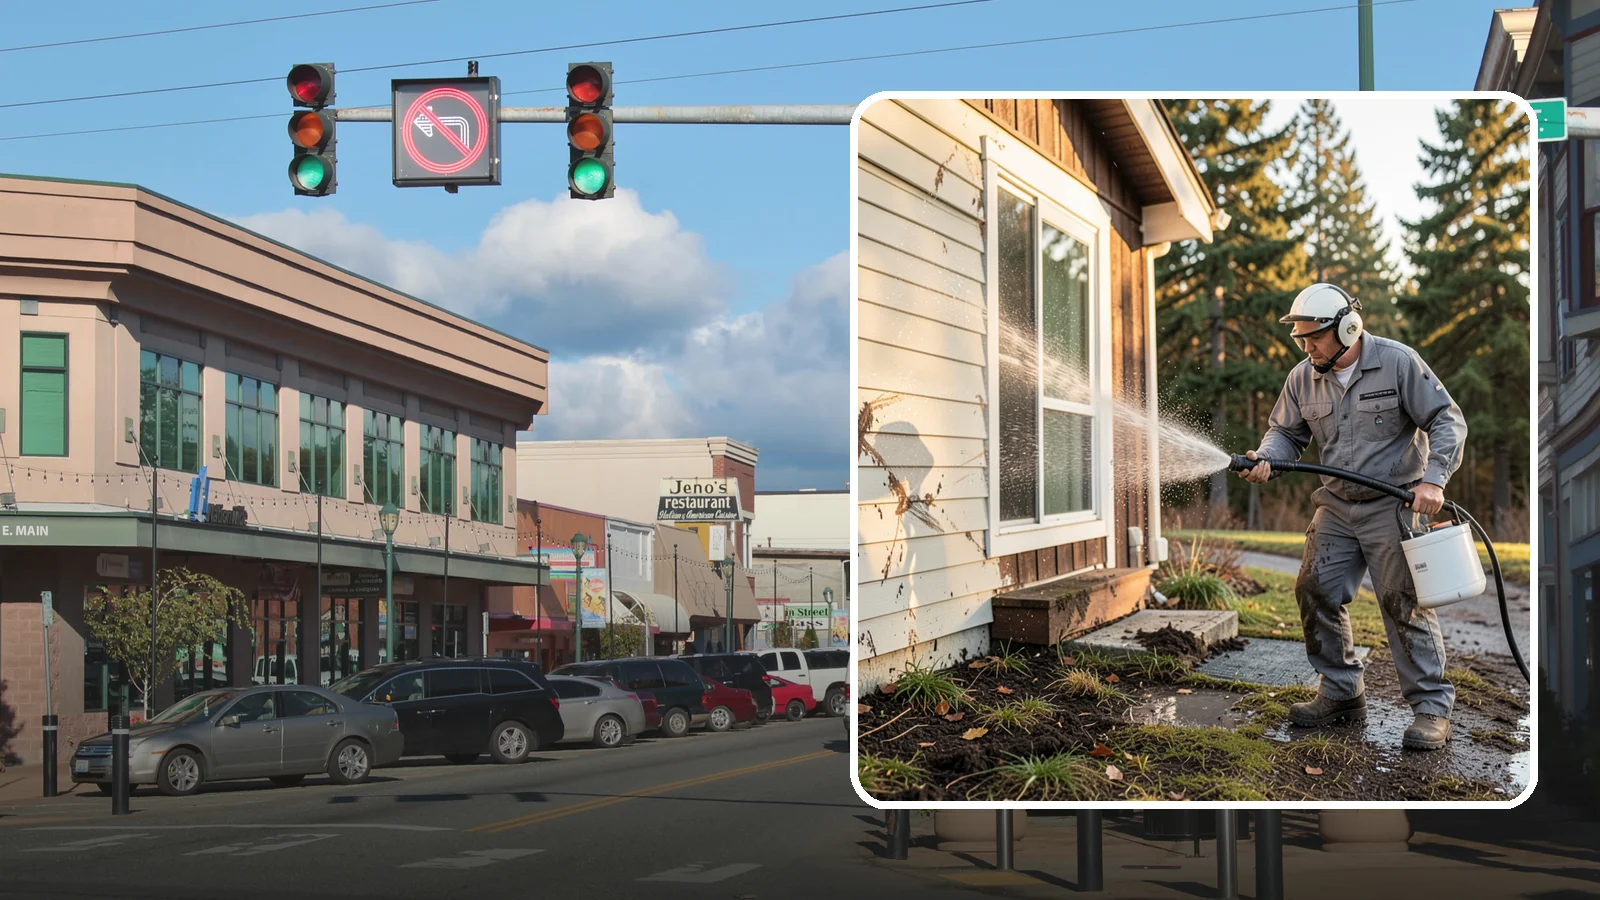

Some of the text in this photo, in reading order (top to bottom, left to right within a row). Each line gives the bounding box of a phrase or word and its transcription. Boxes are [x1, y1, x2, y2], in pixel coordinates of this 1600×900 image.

[670, 480, 727, 494] Jeno's
[665, 496, 731, 509] restaurant
[659, 510, 681, 519] Italian
[686, 510, 714, 519] American
[715, 510, 737, 519] Cuisine
[2, 525, 49, 536] E. MAIN
[797, 608, 828, 616] Street
